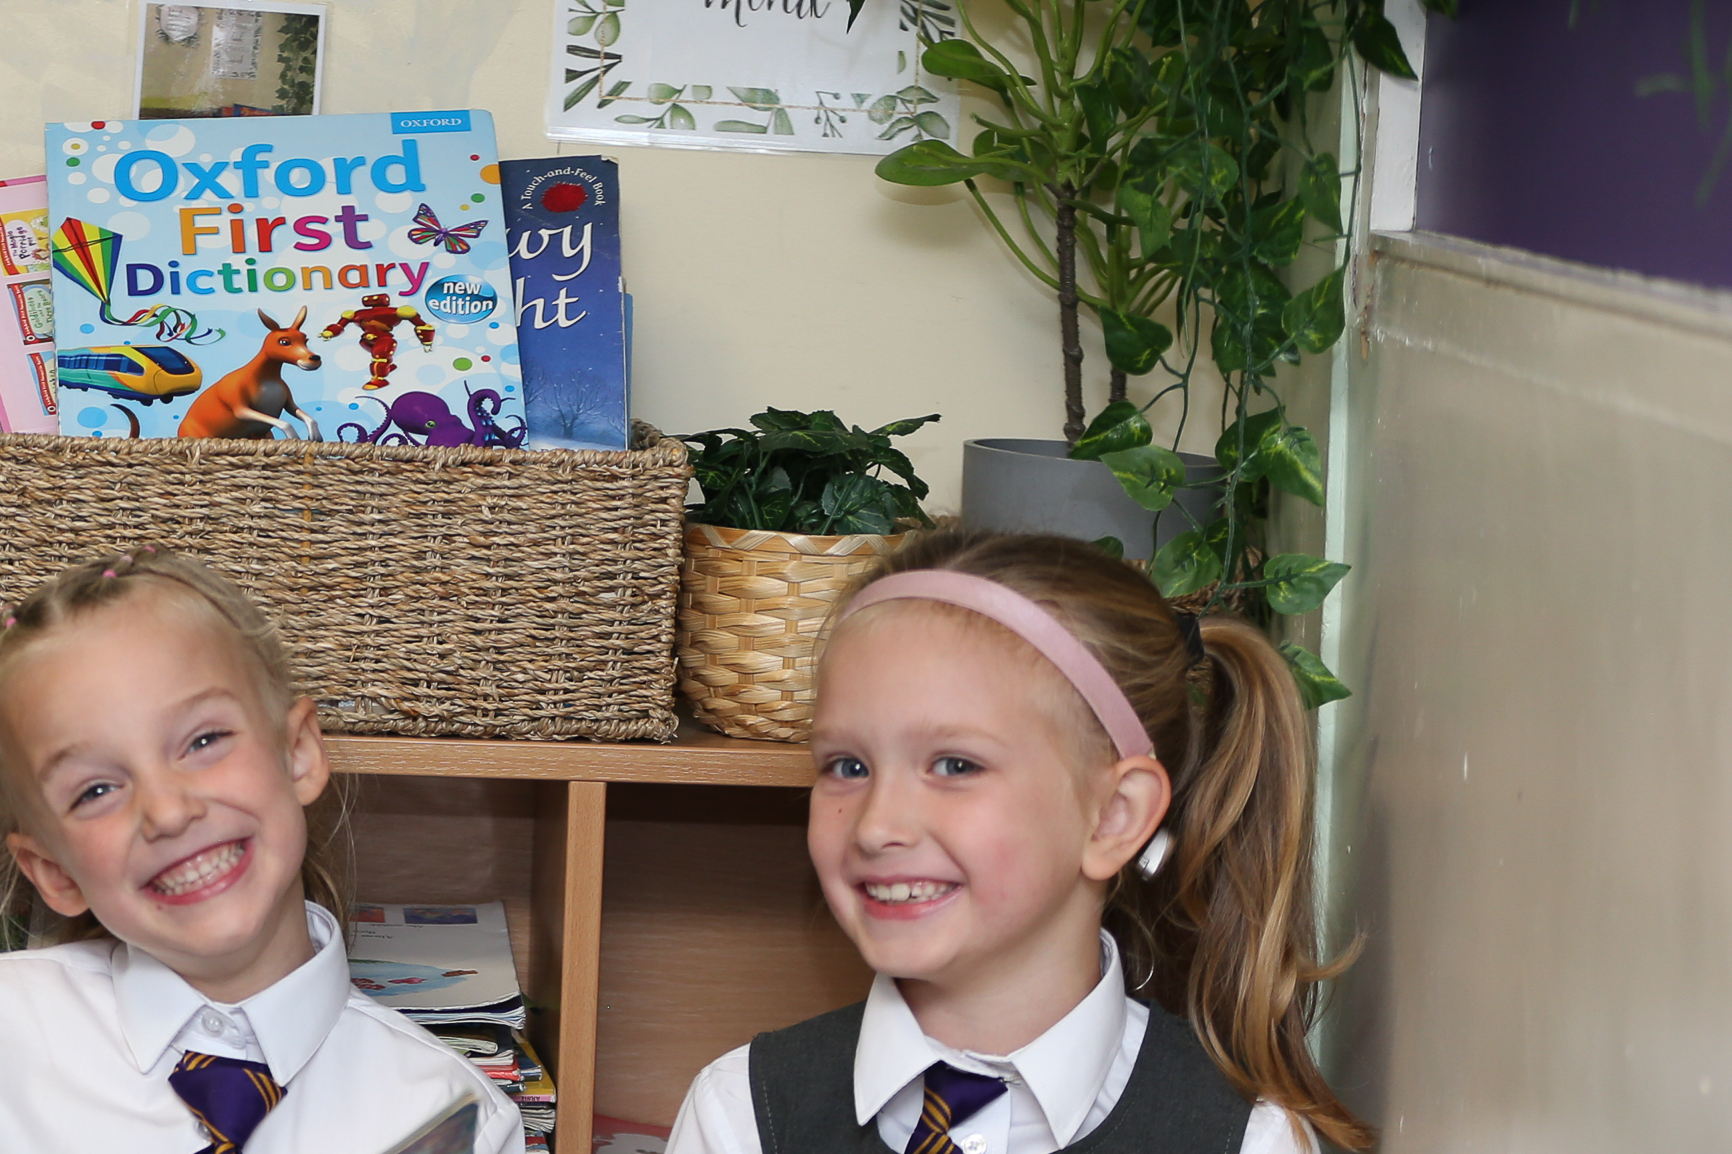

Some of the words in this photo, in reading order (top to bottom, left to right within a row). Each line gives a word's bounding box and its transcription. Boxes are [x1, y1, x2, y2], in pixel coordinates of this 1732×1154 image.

[400, 116, 462, 129] OXFORD
[113, 138, 426, 202] Oxford
[521, 166, 597, 201] Touch-and-Feel
[522, 202, 533, 210] A
[592, 181, 606, 207] Book
[16, 226, 30, 260] Porridge
[179, 203, 373, 256] First
[506, 222, 593, 282] wy
[127, 259, 430, 298] Dictionary
[443, 281, 482, 295] new
[428, 296, 494, 315] edition
[516, 276, 587, 330] ht
